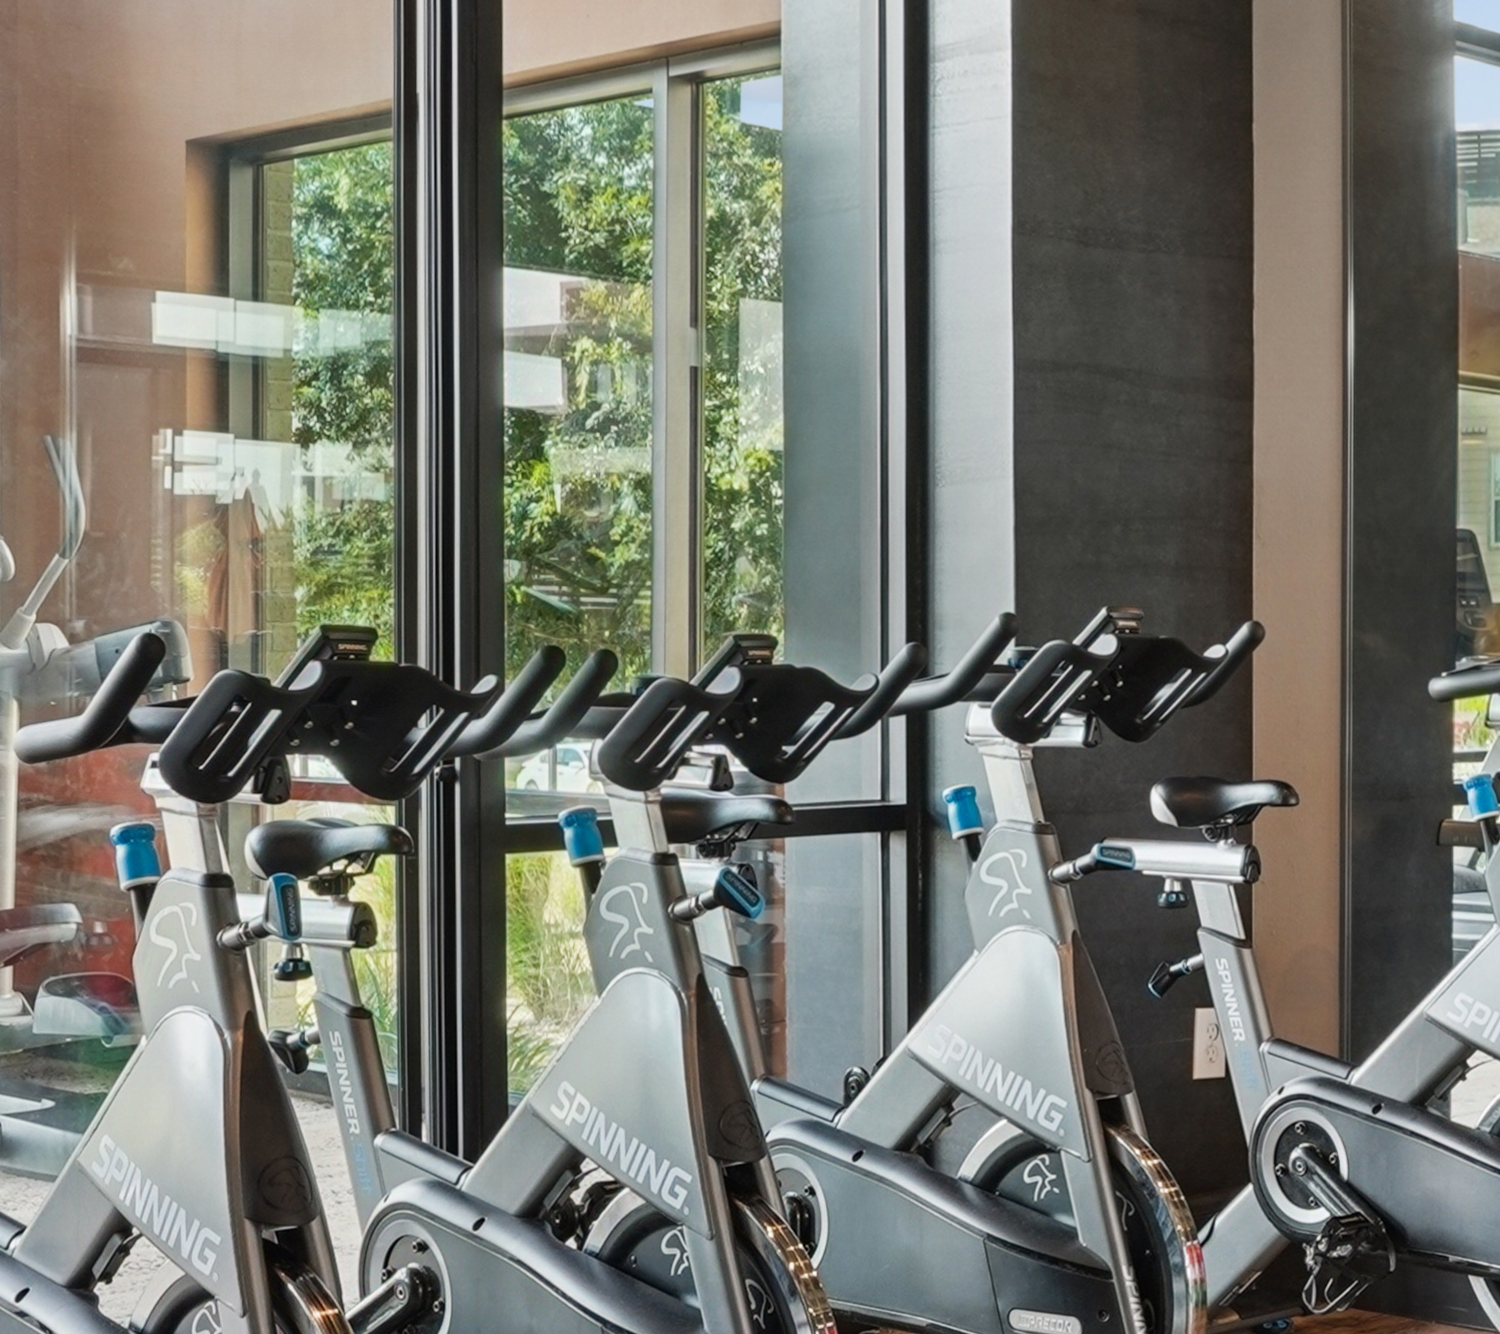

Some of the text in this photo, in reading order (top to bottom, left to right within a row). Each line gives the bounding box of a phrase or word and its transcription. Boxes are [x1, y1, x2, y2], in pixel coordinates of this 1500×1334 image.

[1215, 957, 1246, 1042] SPINNER
[329, 1030, 361, 1135] SPINNER
[928, 1024, 1067, 1132] SPINNING
[549, 1081, 693, 1210] SPINNING
[91, 1134, 222, 1276] SPINNING
